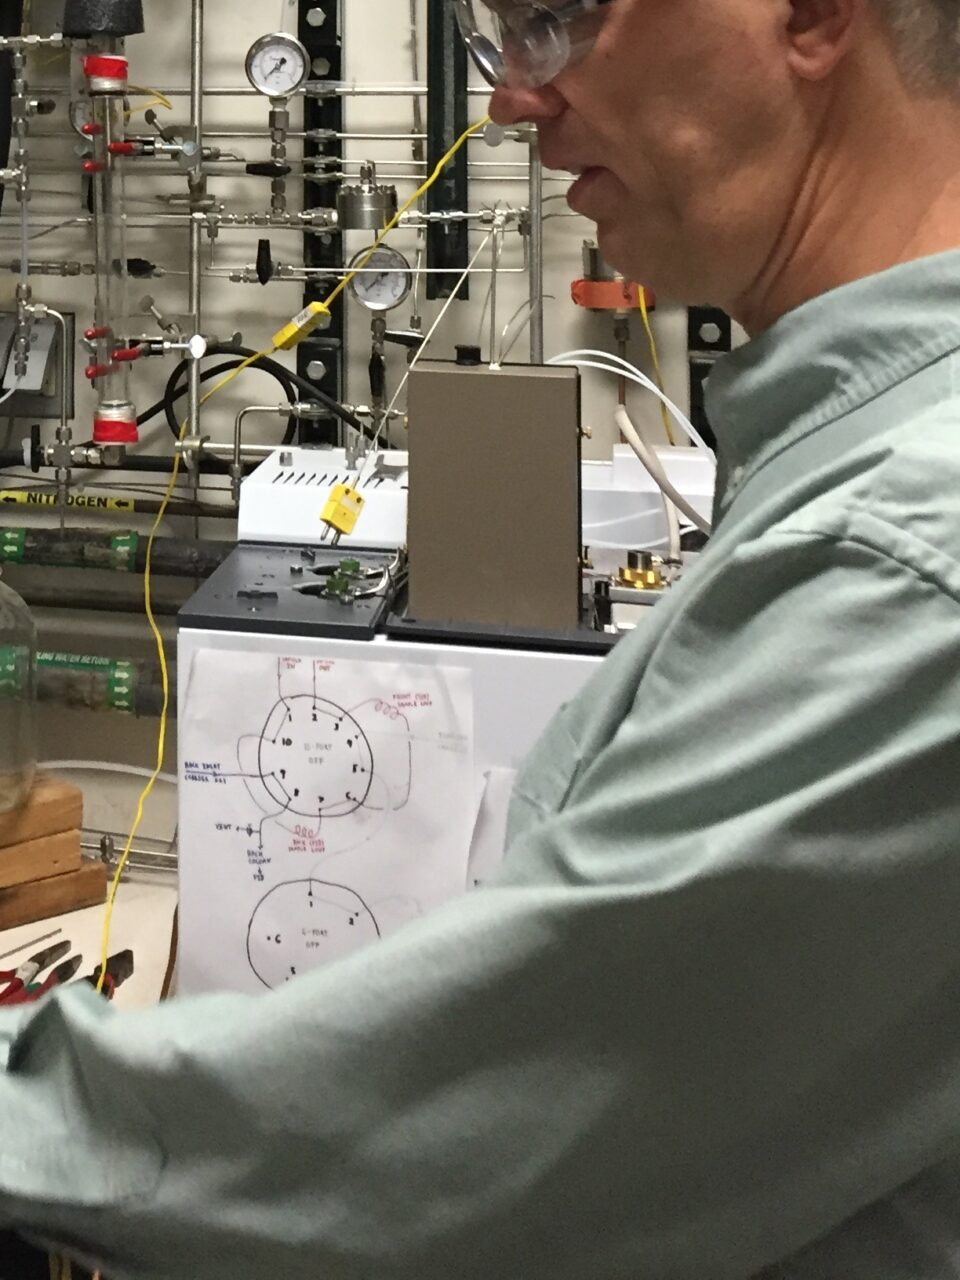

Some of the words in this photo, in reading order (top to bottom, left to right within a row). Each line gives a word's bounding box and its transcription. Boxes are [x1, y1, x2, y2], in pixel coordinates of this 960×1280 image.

[27, 493, 108, 508] NITOGEN
[312, 713, 318, 722] 2
[282, 737, 293, 746] 10
